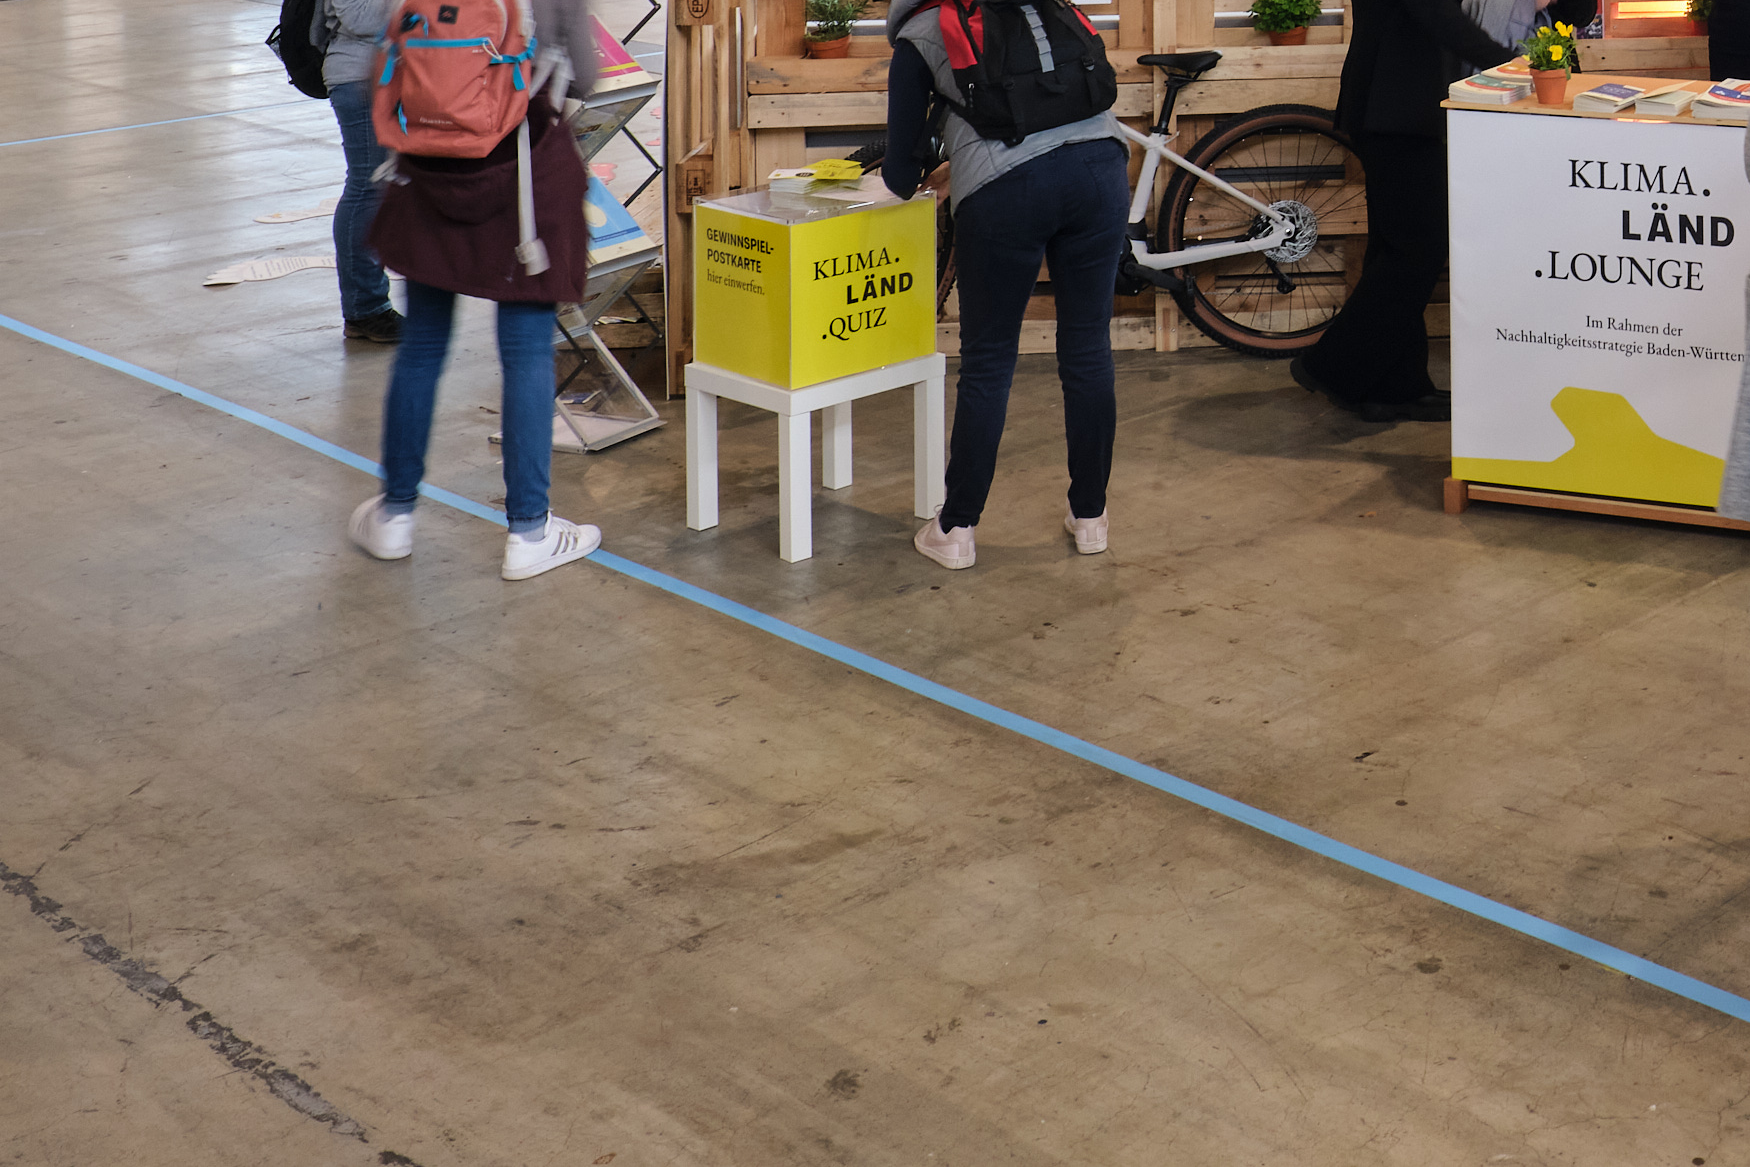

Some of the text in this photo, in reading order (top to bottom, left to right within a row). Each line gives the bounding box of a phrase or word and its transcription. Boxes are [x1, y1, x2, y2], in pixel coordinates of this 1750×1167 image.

[1568, 159, 1711, 197] KLIMA.
[706, 228, 774, 255] GEWINNSPIEL-
[1622, 202, 1735, 247] LÄND
[707, 249, 762, 274] POSTKARTE
[813, 247, 900, 281] KLIMA.
[1534, 250, 1704, 291] .LOUNGE
[706, 269, 765, 296] hier einwerfen.
[846, 271, 913, 305] LÄND
[822, 307, 887, 341] .QUIZ
[1586, 315, 1684, 337] Im Rahmen der
[1496, 328, 1643, 357] Nachhaltigkeitsstrategie
